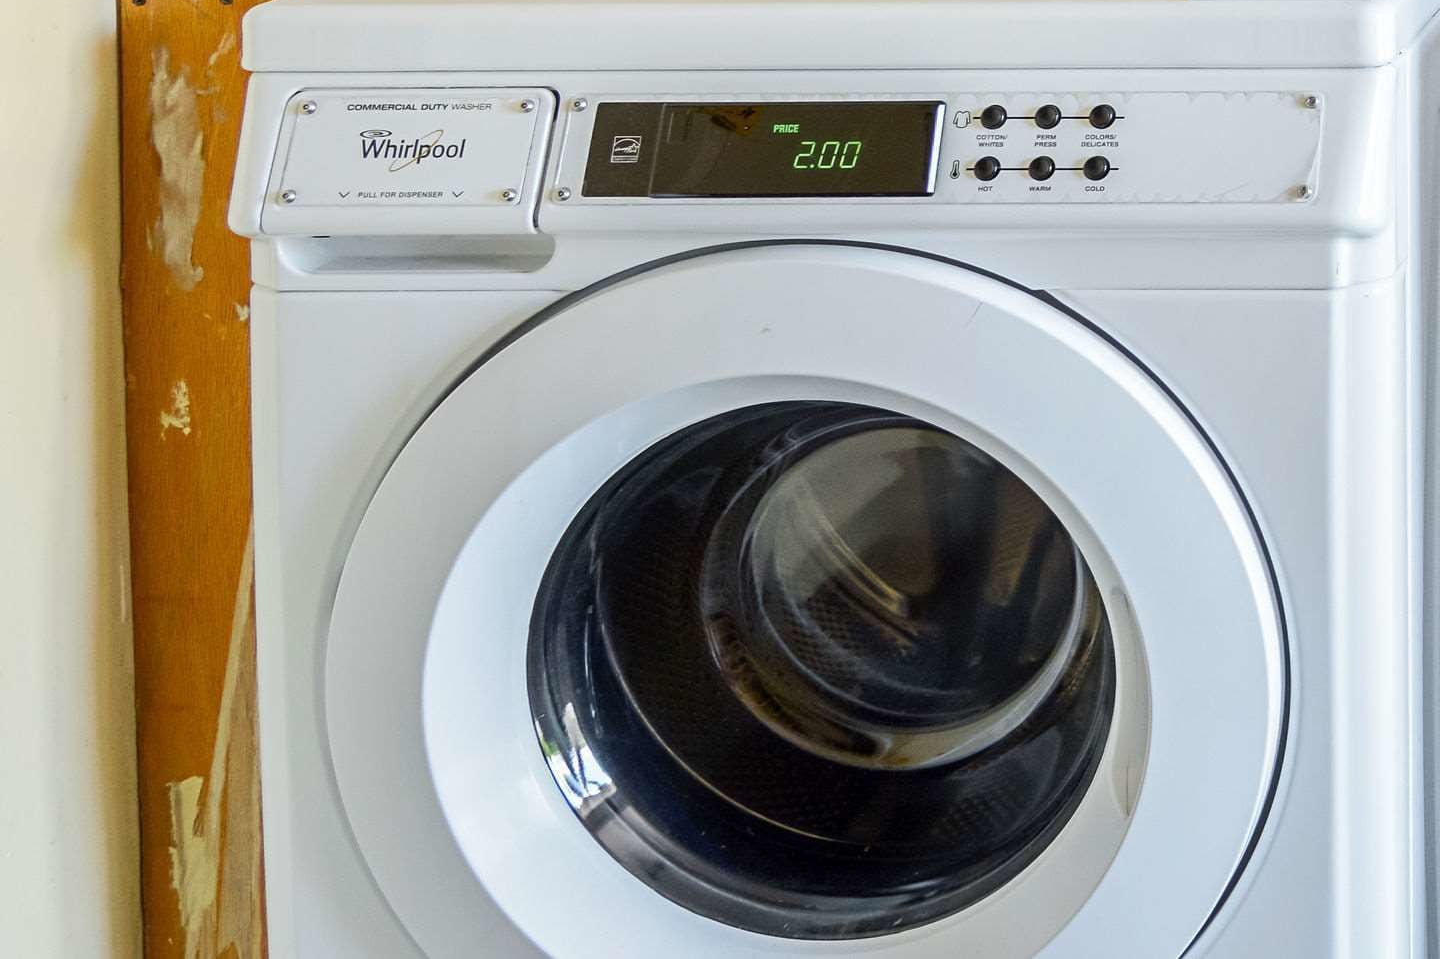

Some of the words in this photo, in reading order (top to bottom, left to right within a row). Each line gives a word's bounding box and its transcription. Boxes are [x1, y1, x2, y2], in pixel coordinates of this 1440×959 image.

[346, 103, 418, 111] COMMERCIAL
[420, 103, 449, 111] DUTY
[451, 103, 492, 111] WASHER
[773, 124, 800, 133] PRICE
[361, 138, 466, 164] Whirlpool
[793, 141, 862, 169] 2.00
